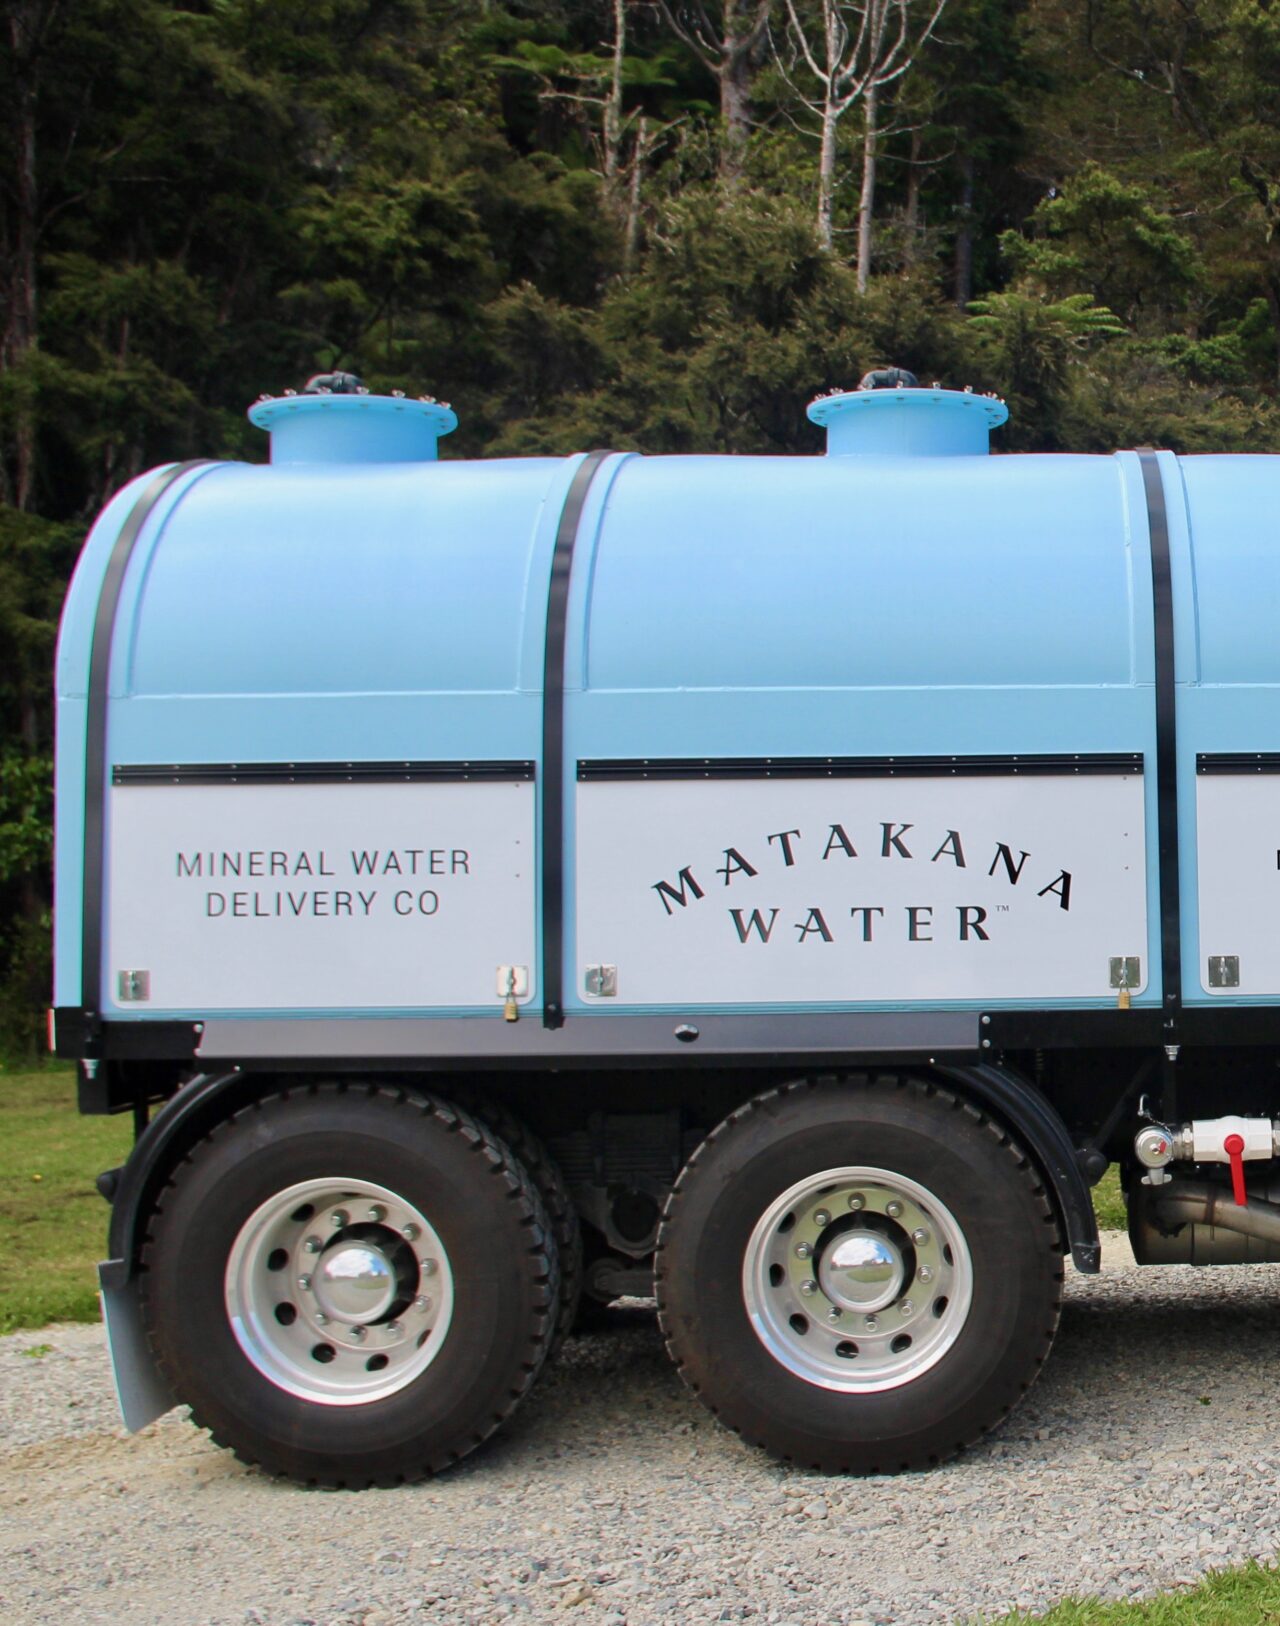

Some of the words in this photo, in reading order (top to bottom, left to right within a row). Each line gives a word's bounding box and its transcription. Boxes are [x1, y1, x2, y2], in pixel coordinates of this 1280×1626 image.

[177, 850, 335, 877] MINERAL
[351, 849, 470, 876] WATER
[651, 822, 1072, 915] MATAKANA
[206, 890, 377, 918] DELIVERY
[393, 889, 439, 916] CO
[728, 905, 990, 944] WATER
